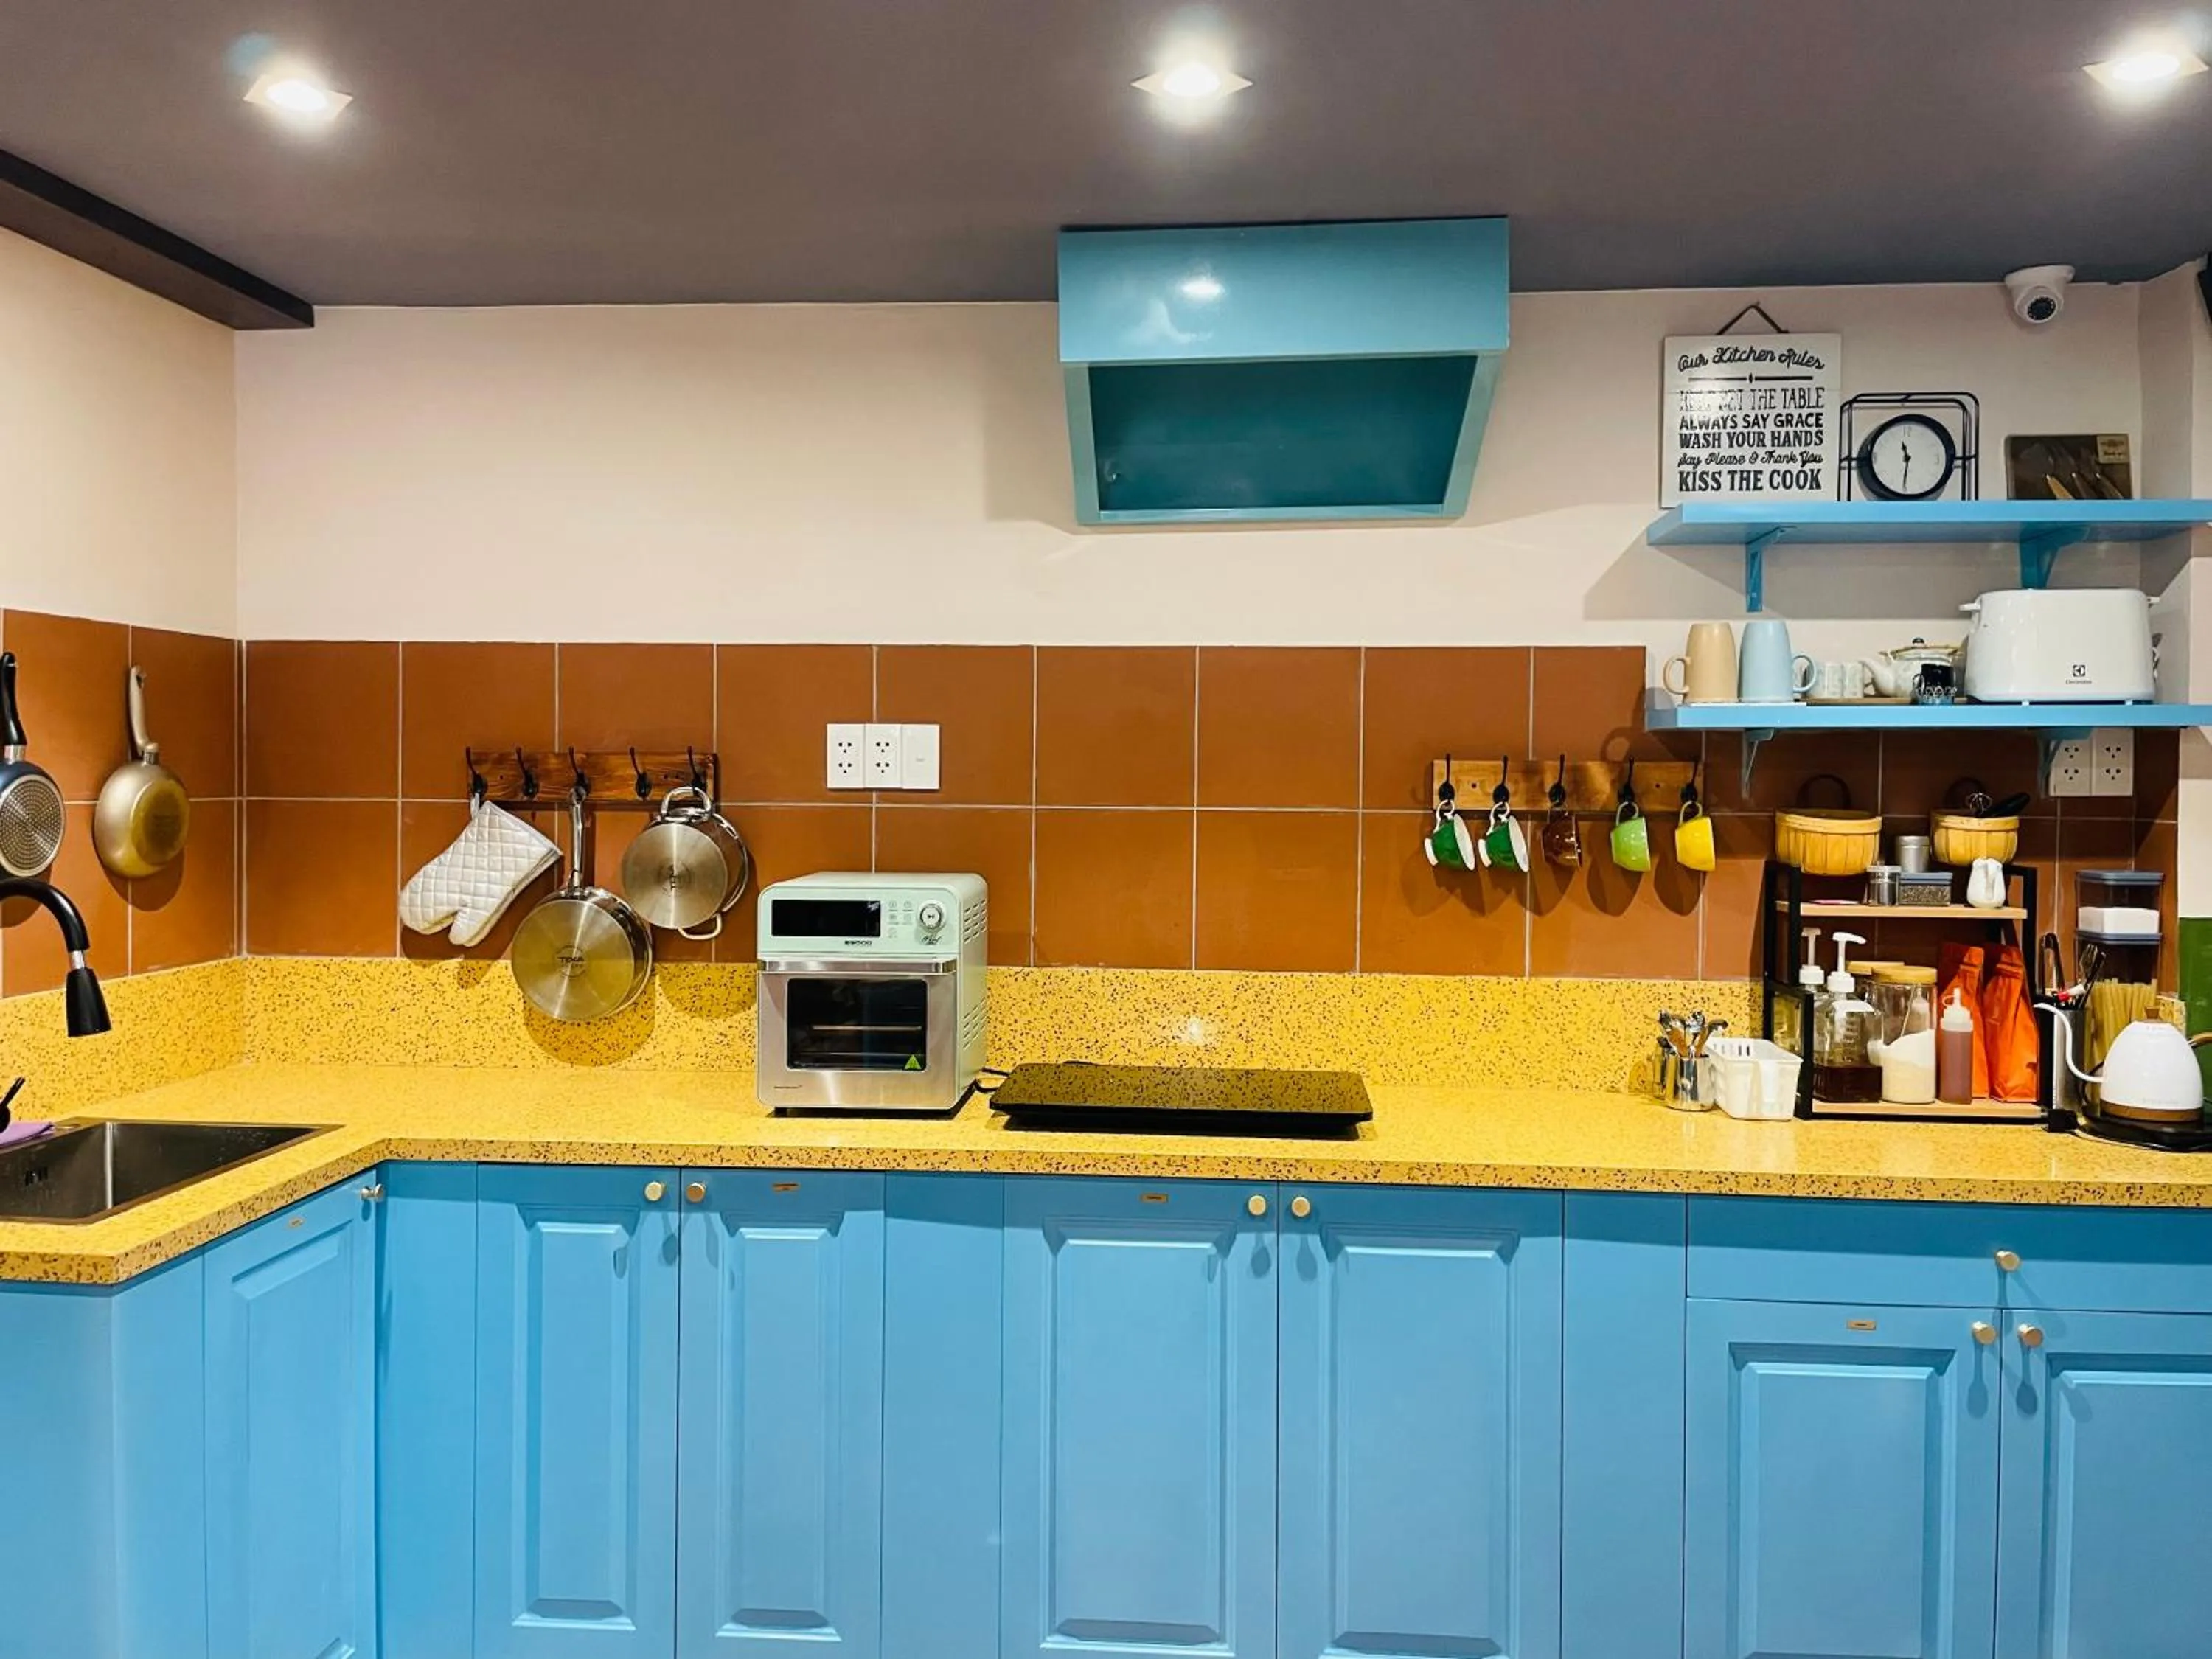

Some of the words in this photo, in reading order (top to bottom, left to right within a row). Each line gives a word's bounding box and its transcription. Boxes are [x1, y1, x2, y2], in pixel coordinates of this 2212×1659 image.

[1677, 353, 1708, 372] Our
[1712, 345, 1776, 364] Kitchen
[1778, 348, 1825, 369] Rules
[1750, 389, 1777, 411] THE
[1781, 387, 1825, 410] TABLE
[1679, 414, 1738, 431] ALWAYS
[1742, 413, 1770, 429] SAY
[1773, 412, 1823, 428] GRACE
[1679, 431, 1722, 449] WASH
[1726, 431, 1767, 448] YOUR
[1770, 430, 1823, 448] HANDS
[1677, 453, 1703, 470] Say
[1704, 452, 1746, 466] Please
[1760, 449, 1798, 465] Thank
[1798, 450, 1823, 468] You
[1678, 470, 1722, 492] KISS
[1727, 470, 1764, 492] THE
[1769, 468, 1822, 490] COOK
